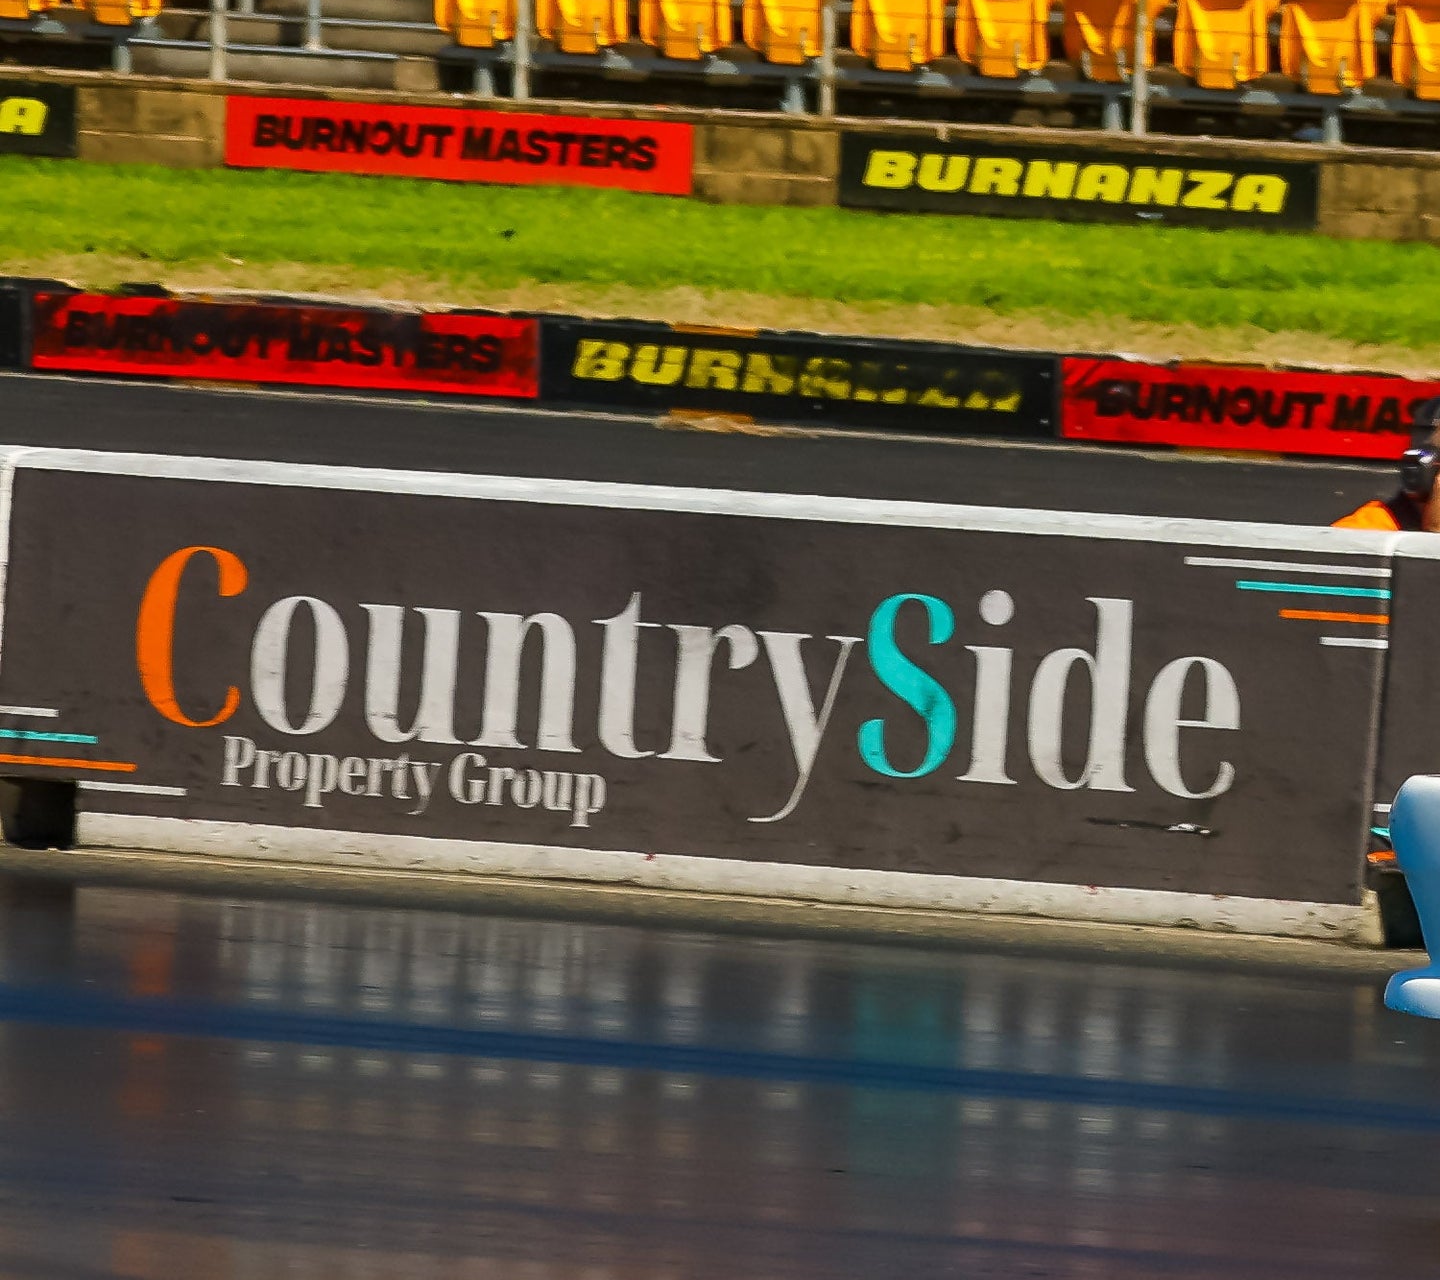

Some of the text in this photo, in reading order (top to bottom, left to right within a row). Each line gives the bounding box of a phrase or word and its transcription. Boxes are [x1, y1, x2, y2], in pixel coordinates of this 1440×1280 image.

[252, 114, 658, 172] BURNOUT MASTERS
[862, 149, 1289, 214] BURNANZA
[1094, 379, 1325, 429] BURNOUT
[136, 546, 1242, 824] CountrySide
[221, 734, 606, 829] Property Group
